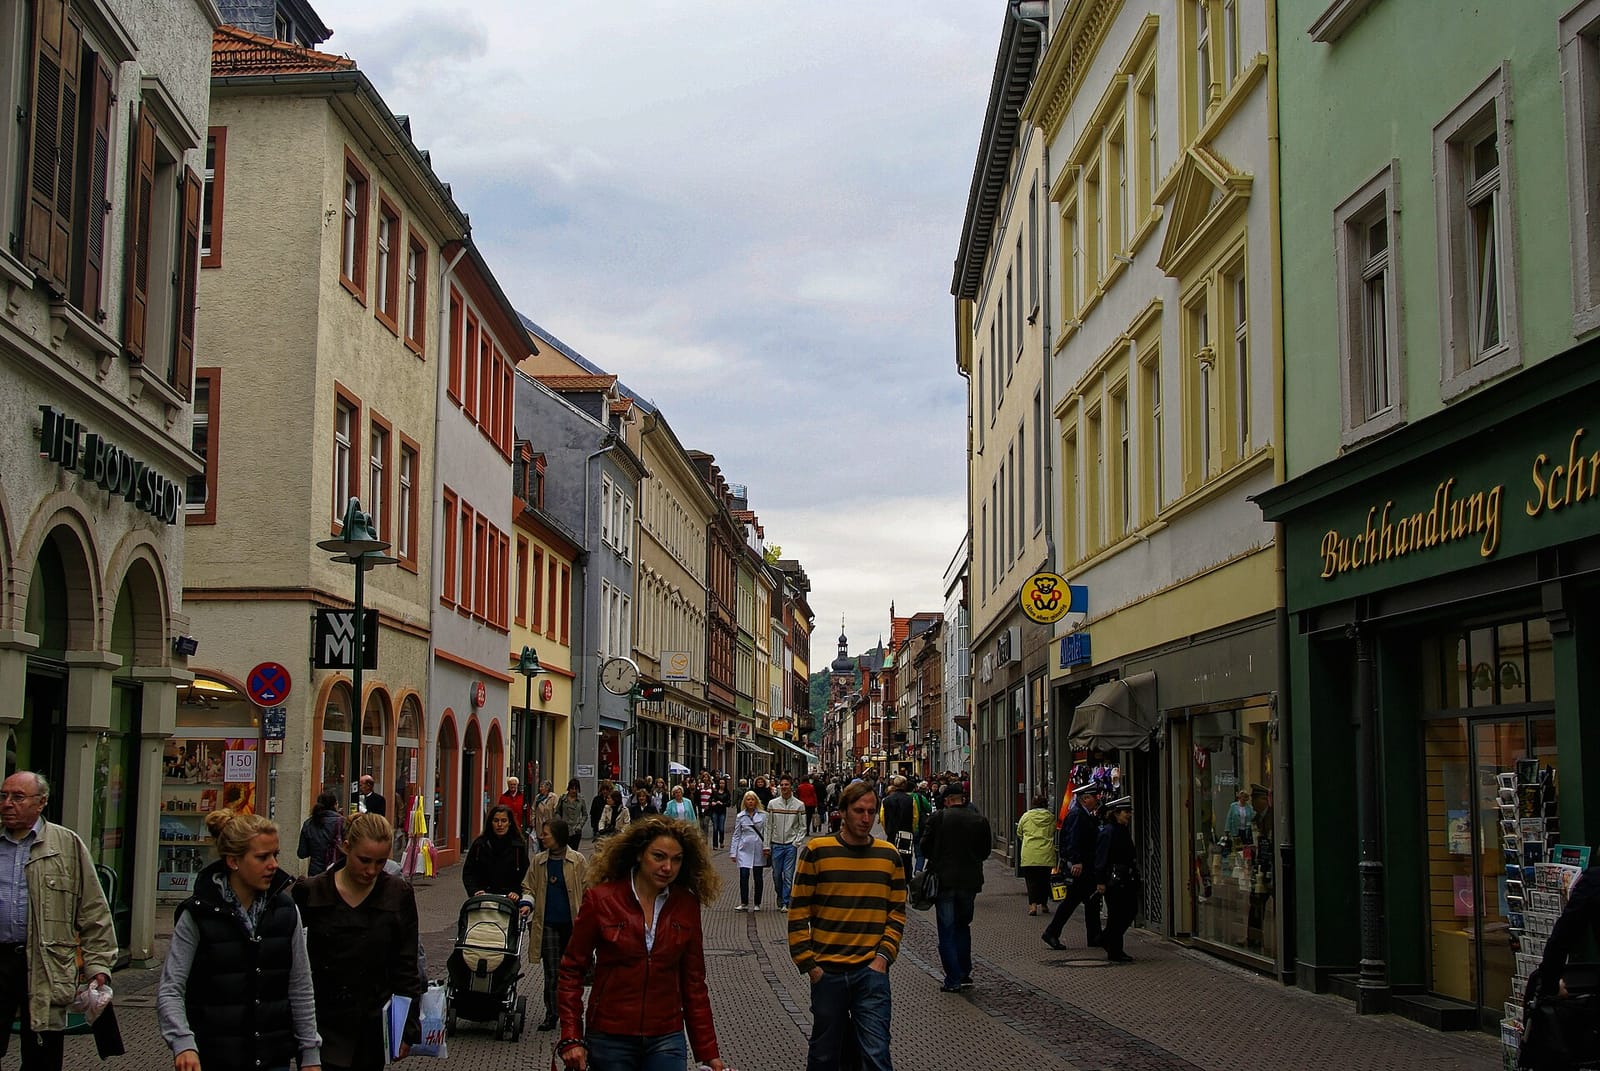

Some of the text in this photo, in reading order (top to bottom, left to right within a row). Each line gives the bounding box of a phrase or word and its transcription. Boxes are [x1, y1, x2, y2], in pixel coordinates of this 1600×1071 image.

[39, 405, 183, 525] THE BODY SHOP
[1319, 477, 1505, 580] Buchhandlung
[229, 754, 252, 767] 150
